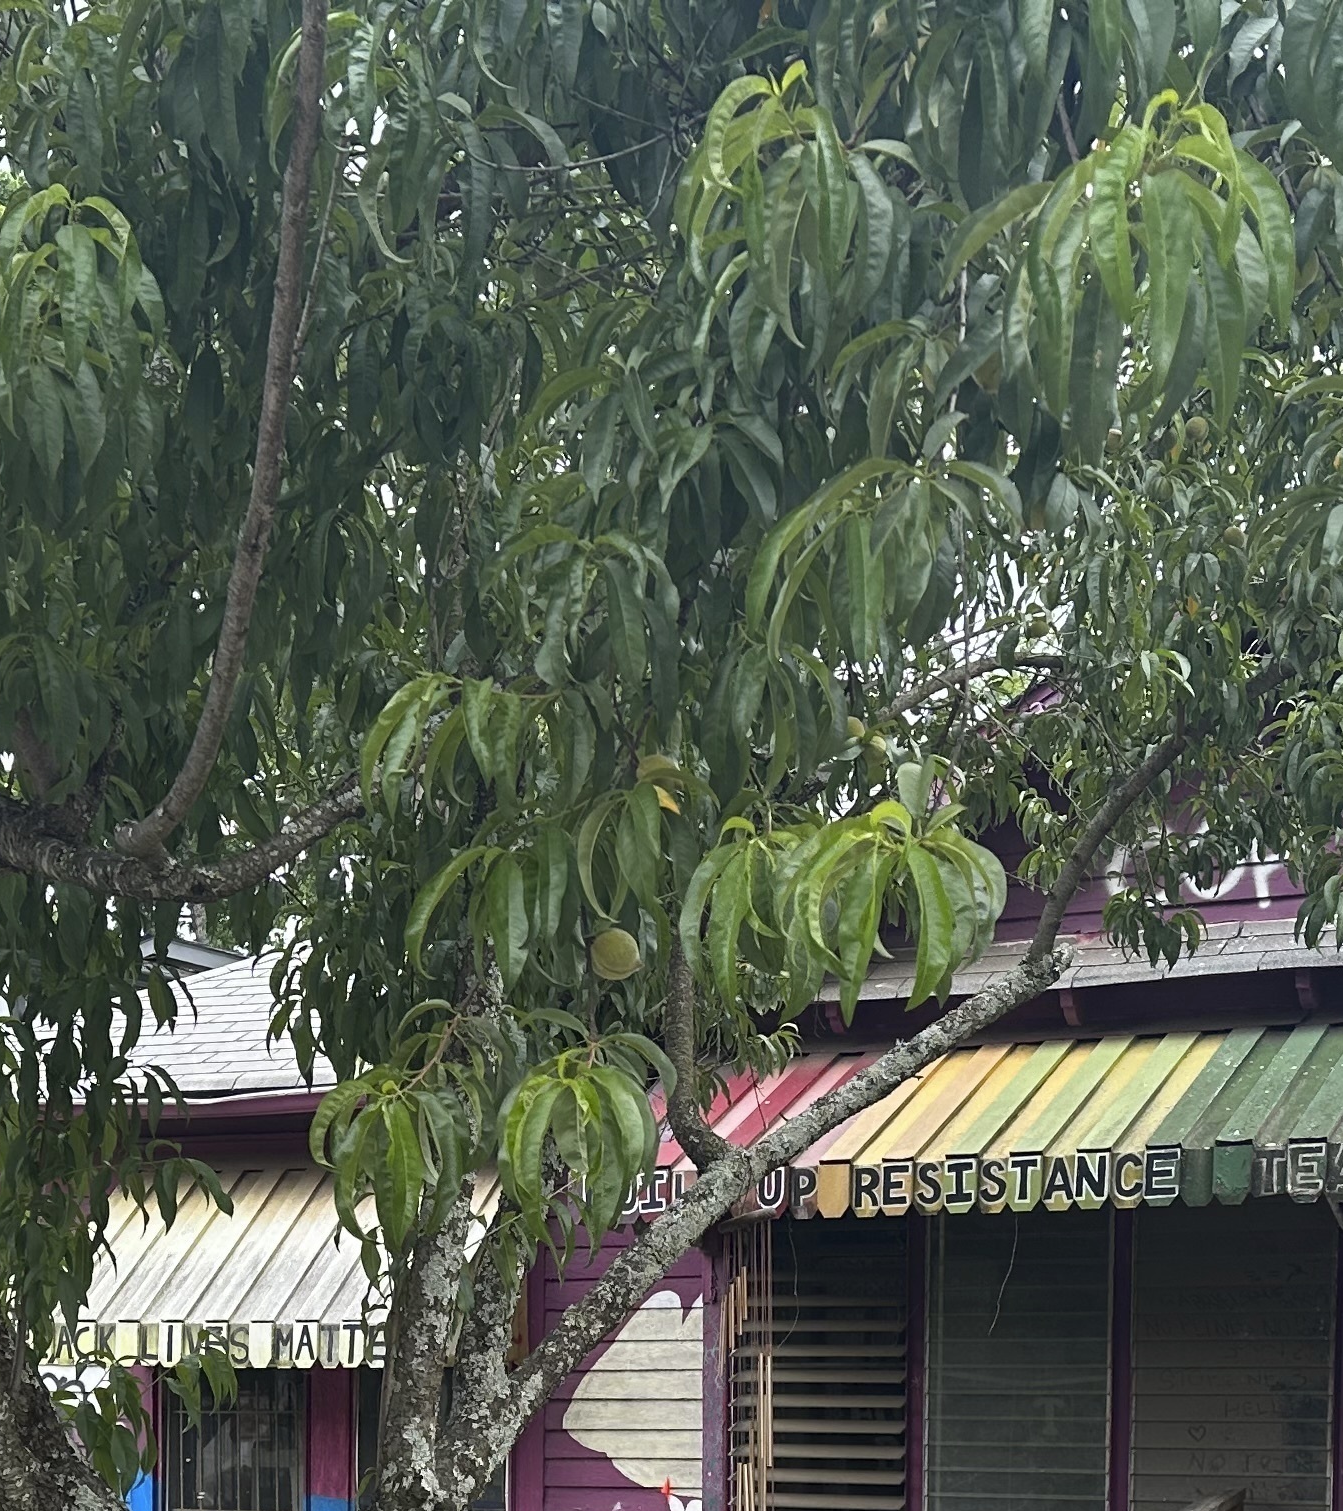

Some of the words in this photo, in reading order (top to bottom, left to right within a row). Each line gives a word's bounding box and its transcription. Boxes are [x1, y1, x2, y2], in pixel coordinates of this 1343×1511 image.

[756, 1164, 818, 1210] UP
[854, 1147, 1182, 1208] RESISTANCE
[275, 1323, 386, 1365] MATTE
